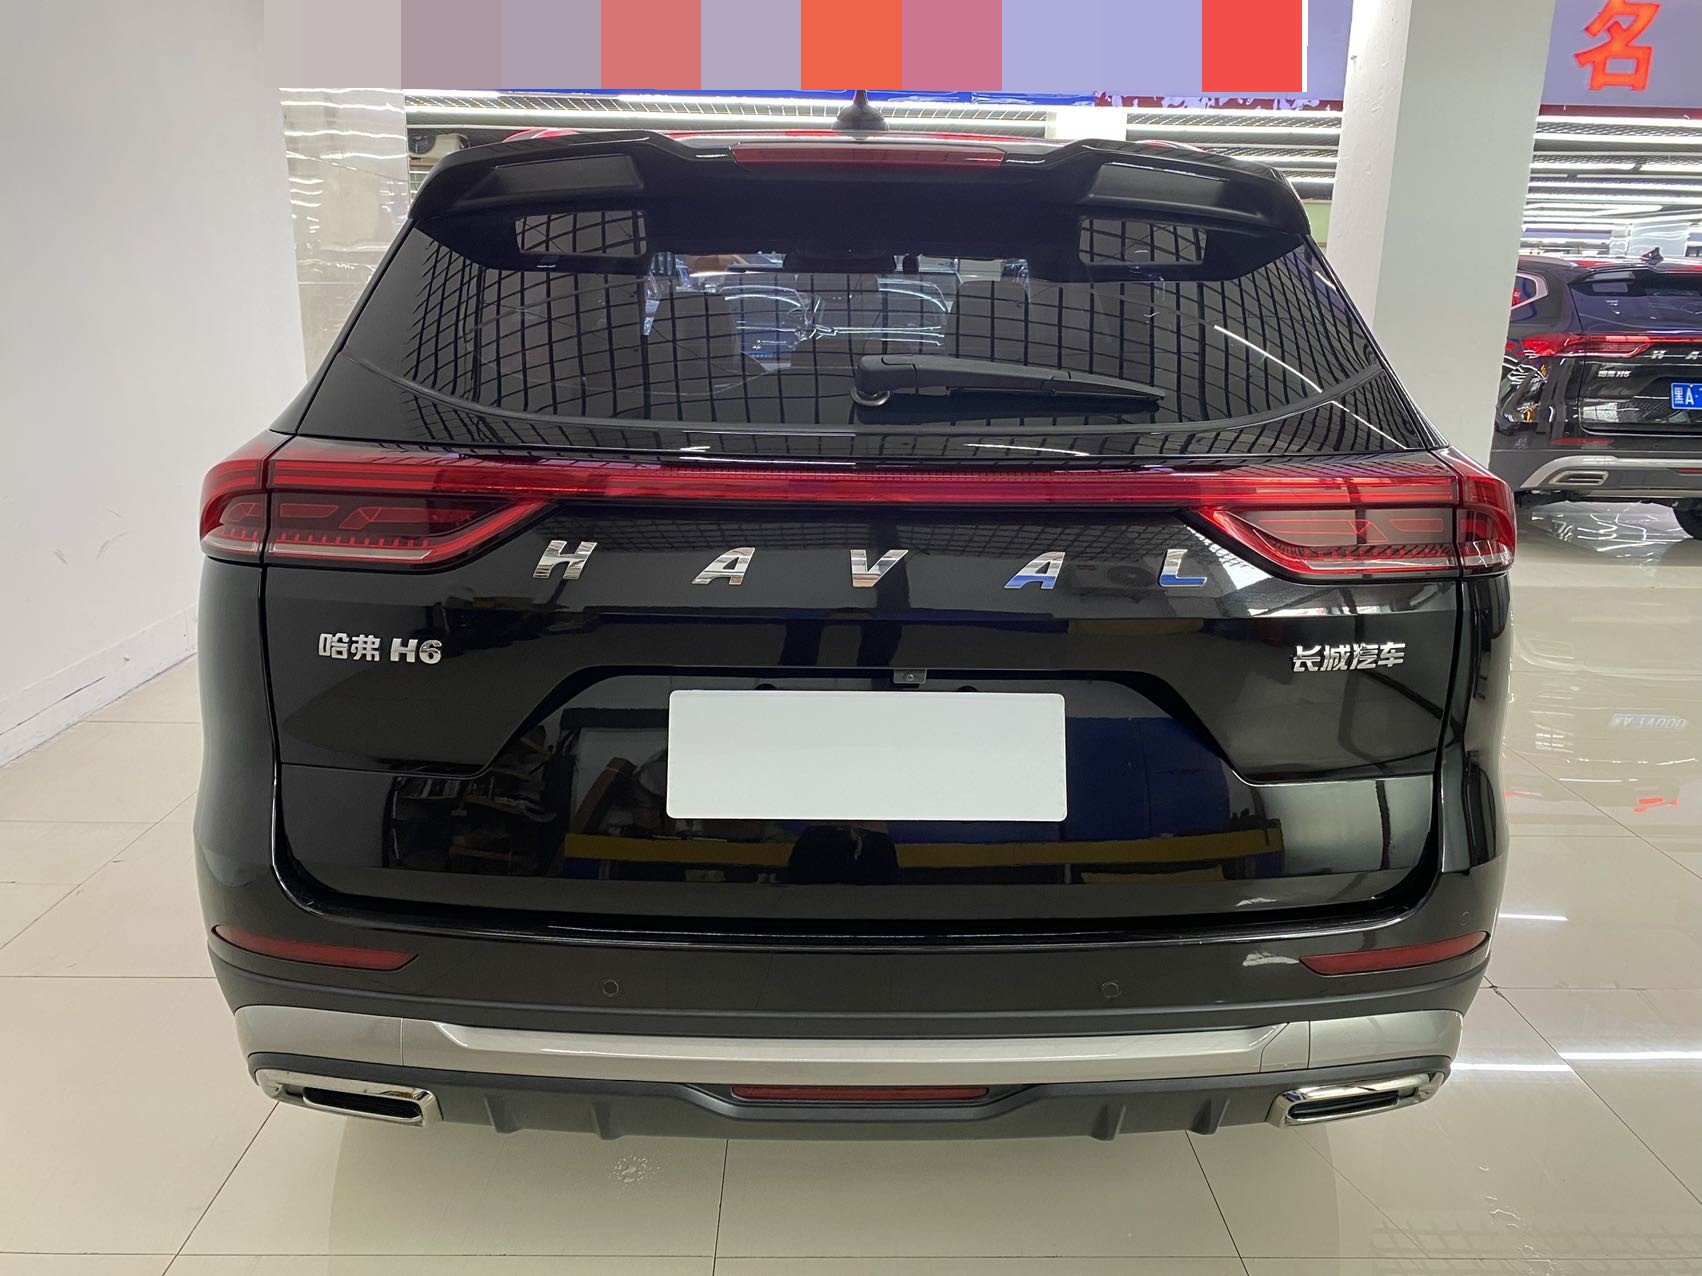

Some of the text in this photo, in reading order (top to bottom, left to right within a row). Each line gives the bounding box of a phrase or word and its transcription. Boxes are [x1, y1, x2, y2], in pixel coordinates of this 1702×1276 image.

[1574, 0, 1661, 91] 名
[532, 540, 1208, 588] HAVAL
[318, 632, 443, 665] 哈弗 H6
[1293, 641, 1406, 673] 长城汽车
